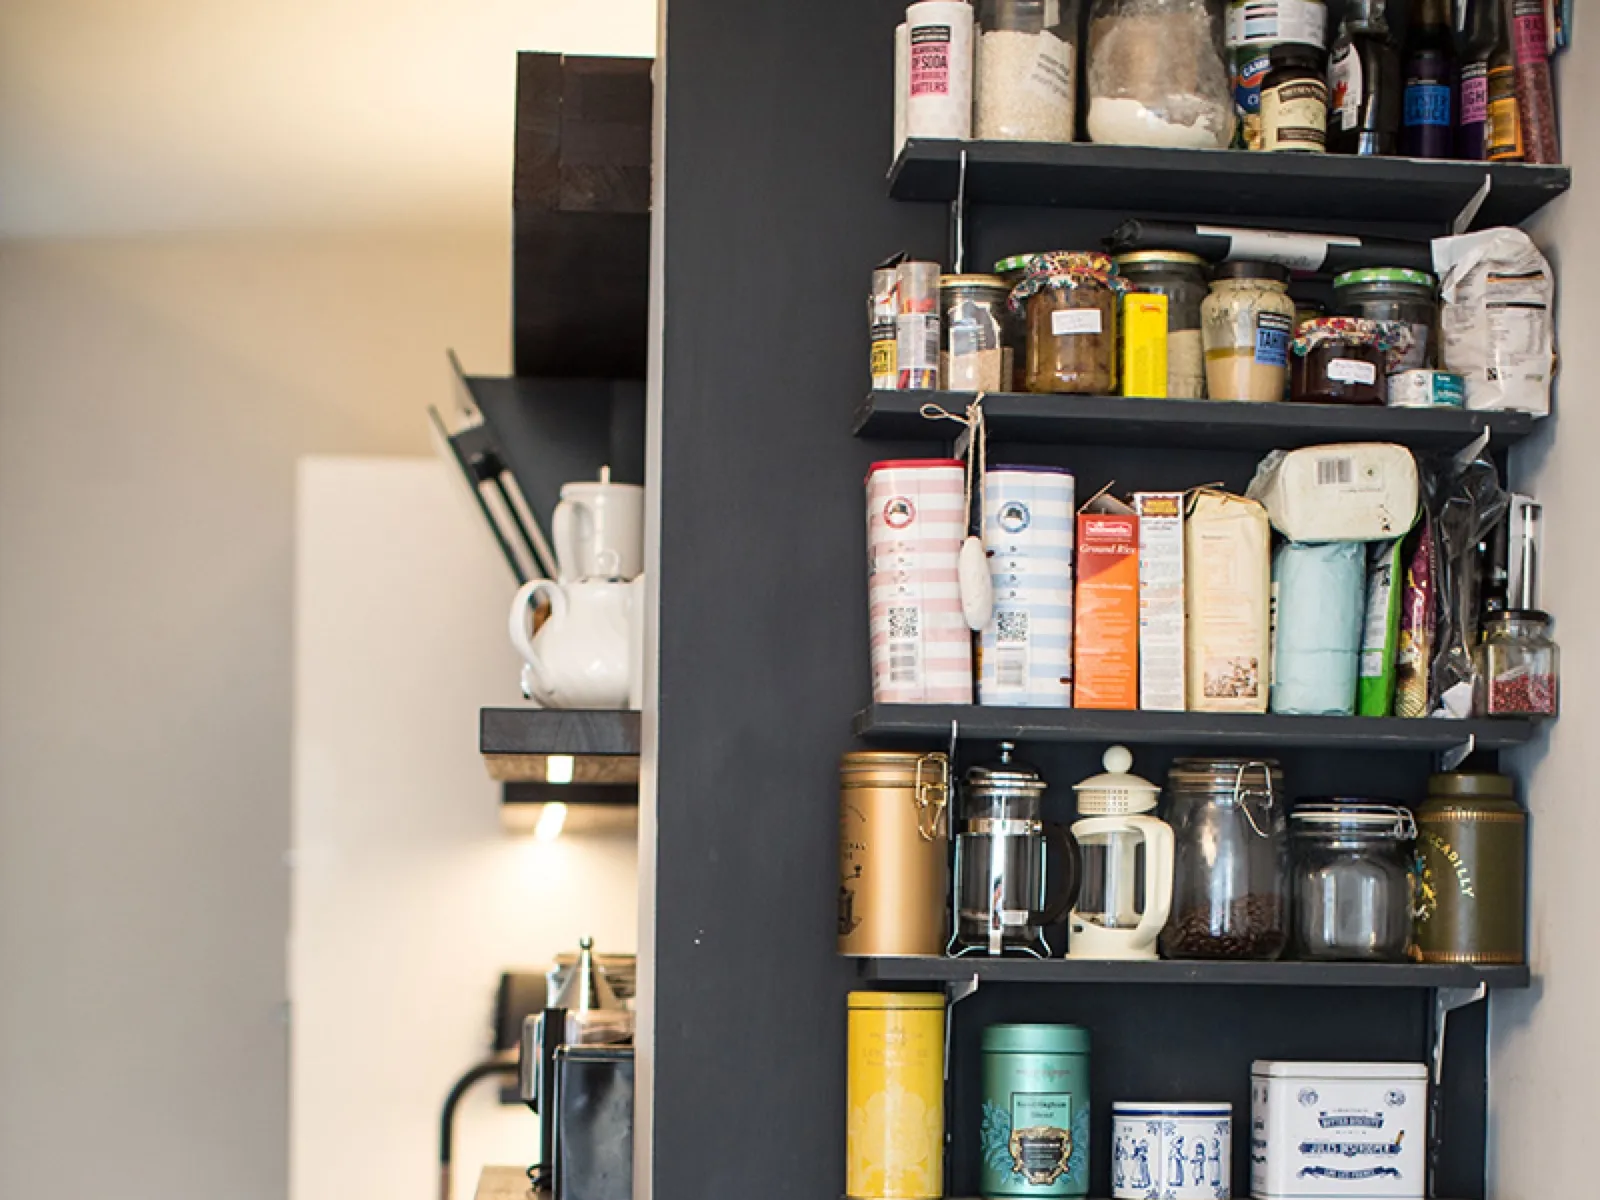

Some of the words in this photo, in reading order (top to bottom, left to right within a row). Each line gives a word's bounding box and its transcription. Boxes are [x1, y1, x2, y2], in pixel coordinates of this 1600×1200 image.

[922, 55, 948, 70] SODA
[1079, 543, 1116, 554] Ground
[1117, 543, 1136, 554] Rice
